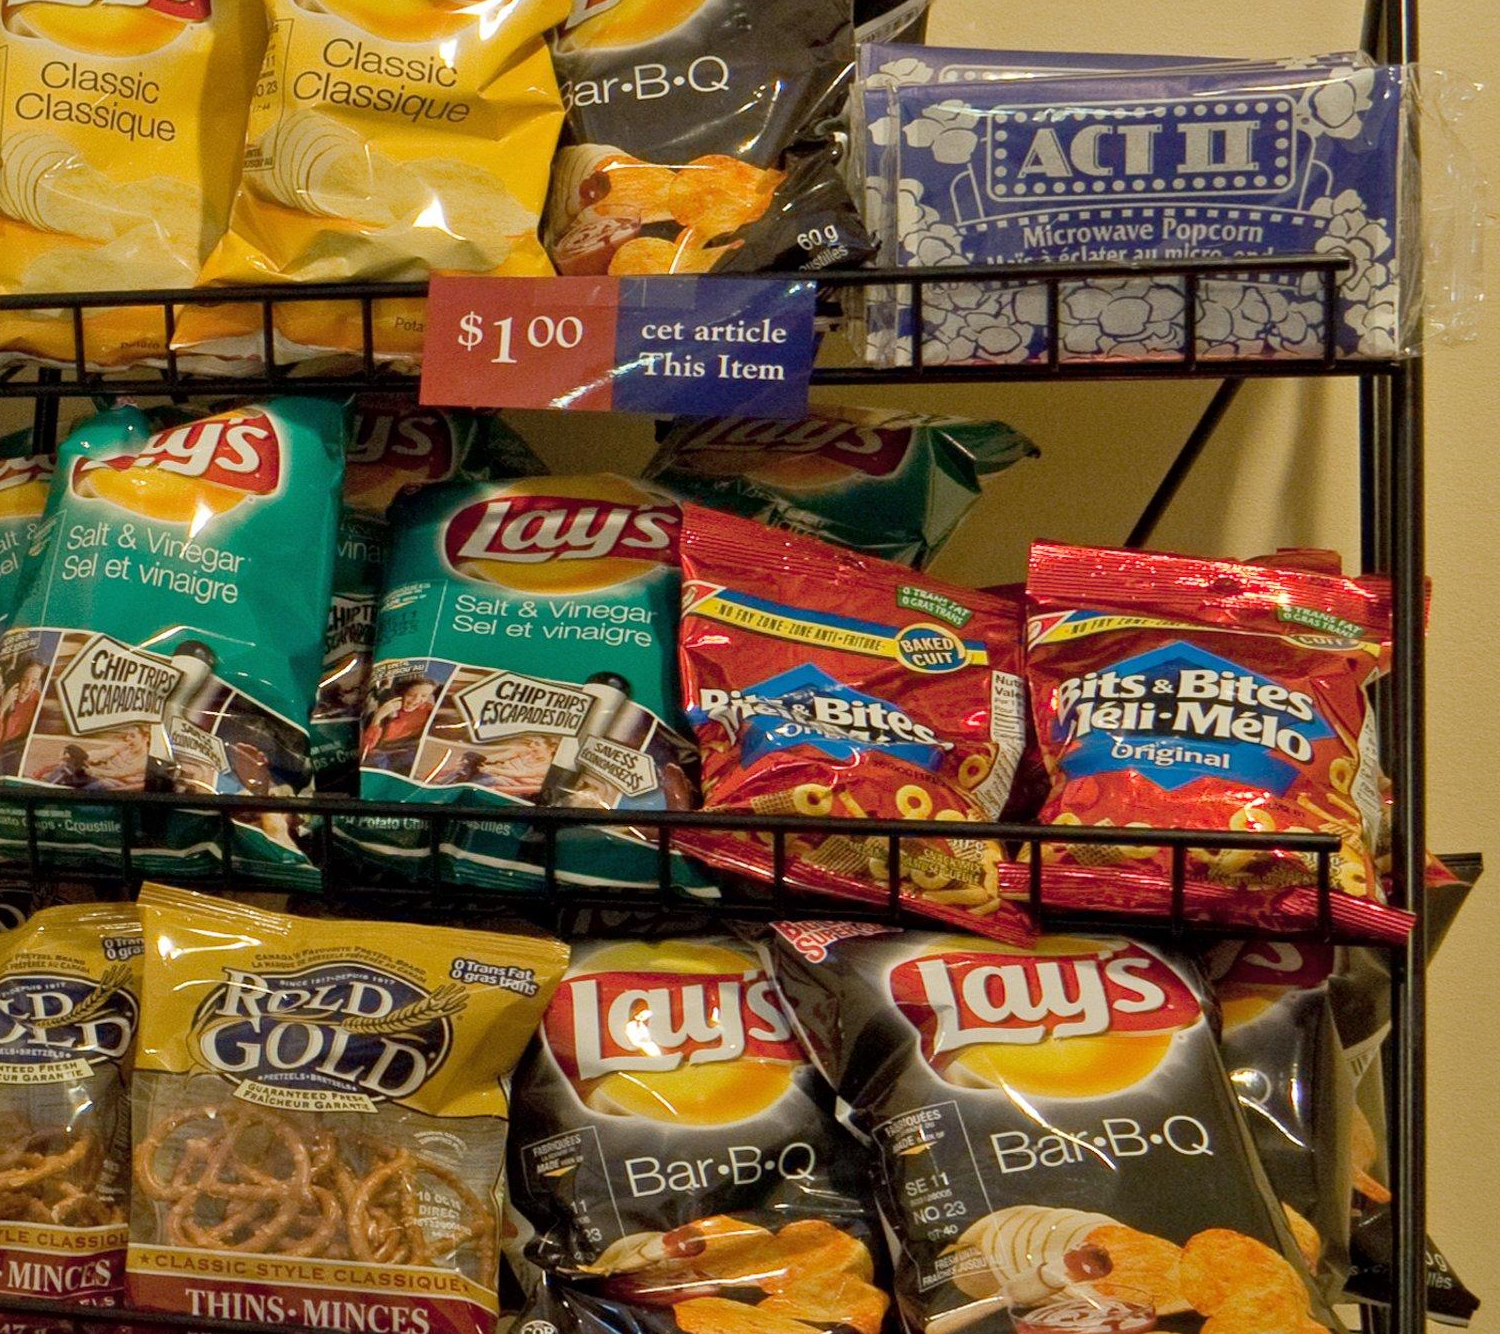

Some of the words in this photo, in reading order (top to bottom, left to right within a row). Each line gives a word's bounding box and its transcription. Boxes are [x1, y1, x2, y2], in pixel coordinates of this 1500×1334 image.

[322, 38, 458, 88] Classic
[41, 61, 159, 104] Classic
[293, 70, 471, 124] Classique
[14, 93, 176, 142] Classique
[1019, 122, 1163, 178] ACT
[1023, 219, 1154, 249] Microwave
[1162, 217, 1263, 244] Popcorn
[640, 324, 688, 343] cet
[697, 322, 788, 344] article
[638, 352, 707, 377] This
[718, 354, 786, 380] Item
[68, 523, 111, 552] Salt
[119, 527, 138, 547] &
[146, 527, 245, 573] Vinegar
[62, 553, 96, 581] Sel
[104, 559, 130, 583] et
[138, 562, 239, 605] vinaigre
[455, 595, 511, 618] Salt
[520, 598, 540, 618] &
[549, 598, 658, 626] Vinegar
[451, 615, 492, 638] Sel
[501, 618, 528, 638] et
[535, 618, 652, 647] vinaigre
[900, 637, 955, 654] BAKED
[911, 651, 952, 666] CUIT
[1059, 672, 1146, 726] Bits
[1152, 678, 1173, 694] &
[1177, 669, 1313, 721] Bites
[1111, 741, 1230, 769] Original
[917, 951, 1178, 1051] Lay's
[201, 1012, 428, 1097] GOLD
[905, 1181, 928, 1197] SE
[931, 1171, 950, 1188] 11
[914, 1206, 939, 1224] NO
[946, 1200, 966, 1217] 23
[156, 1255, 238, 1277] CLASSIC
[246, 1261, 325, 1282] STYLE
[334, 1267, 462, 1293] CLASSIQUE
